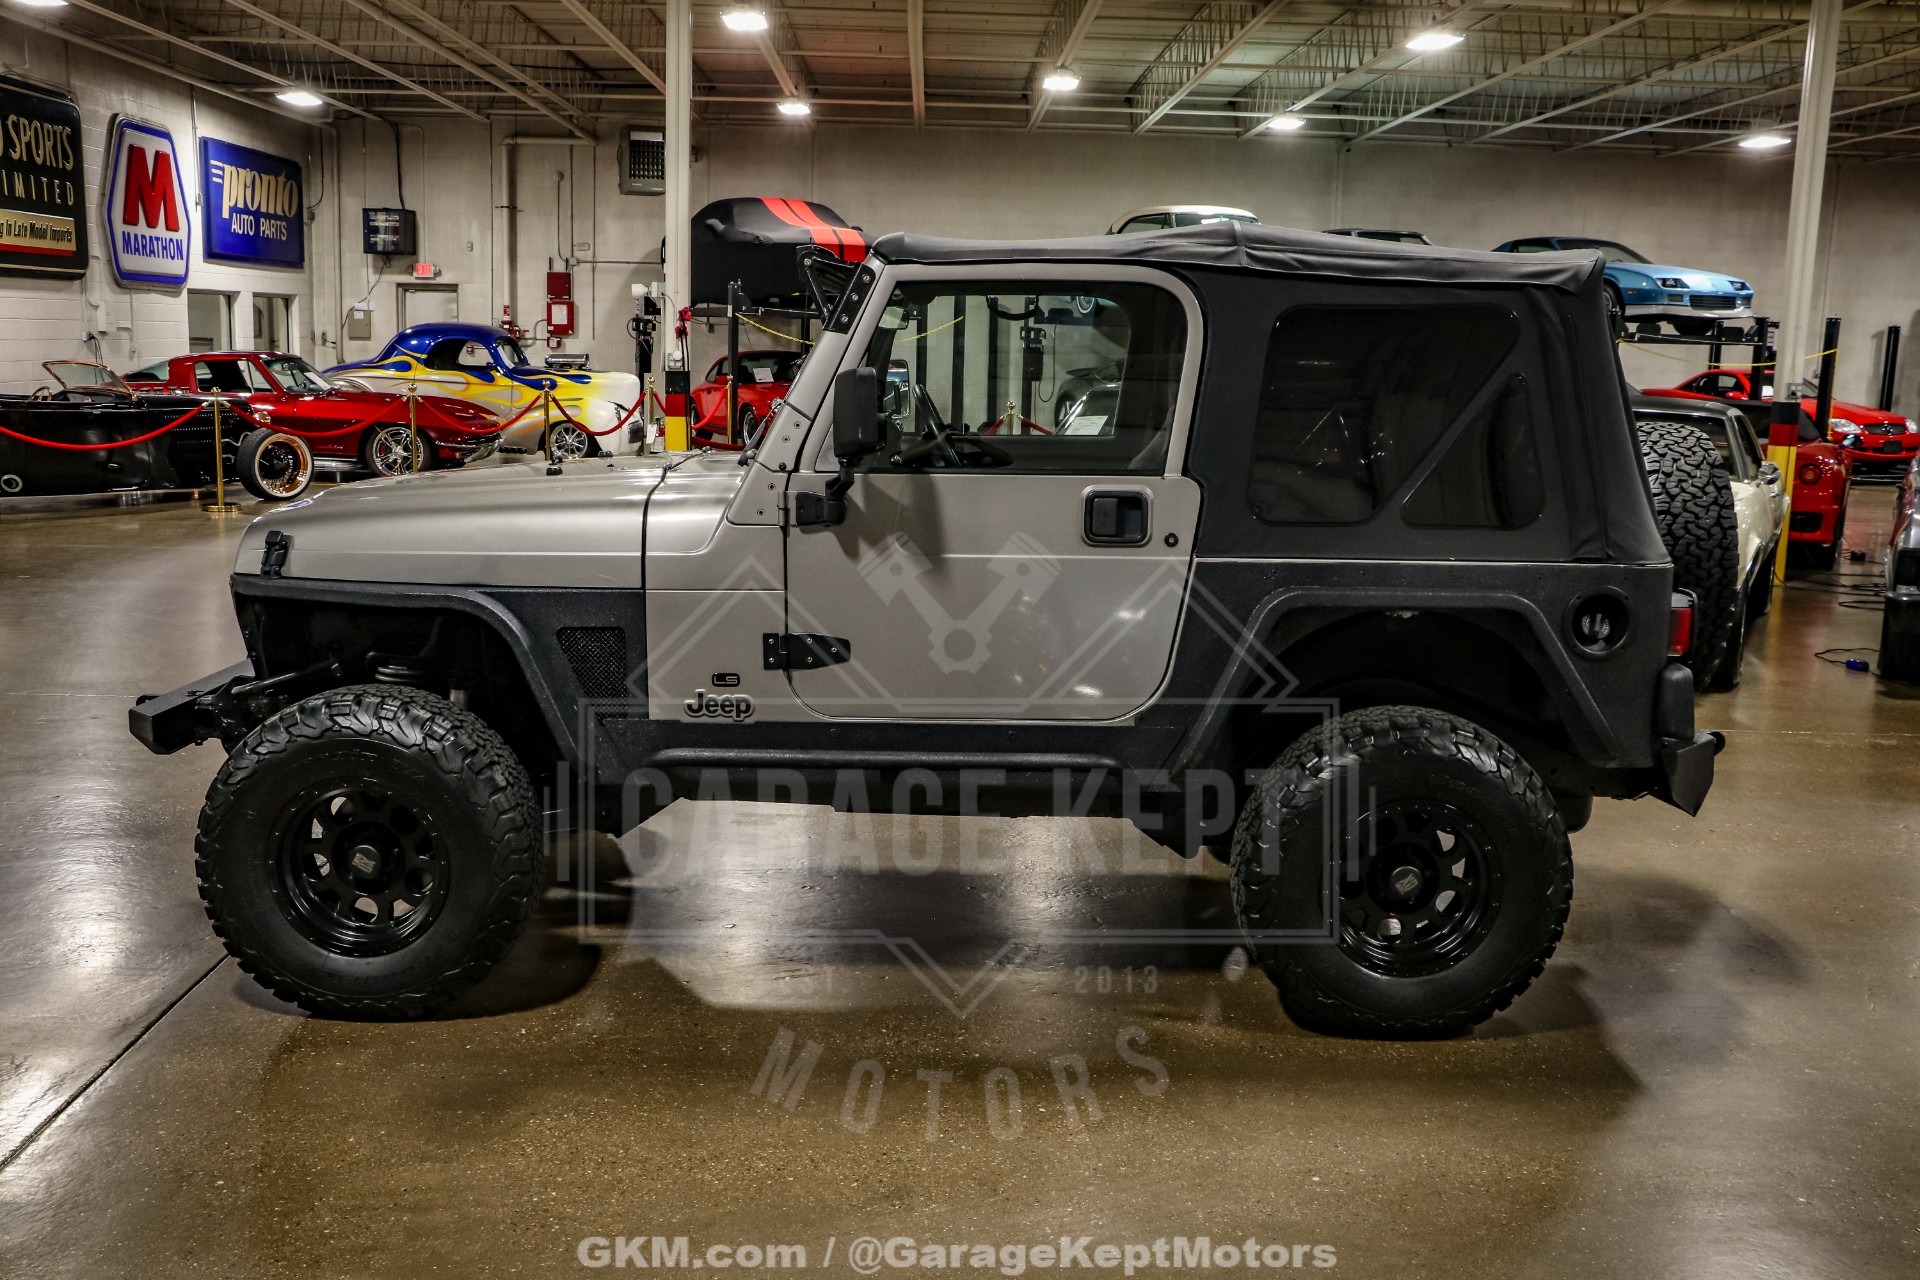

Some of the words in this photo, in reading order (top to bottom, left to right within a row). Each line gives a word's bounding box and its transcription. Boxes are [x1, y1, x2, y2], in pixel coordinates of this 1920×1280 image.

[7, 114, 74, 171] SPORTS
[122, 143, 180, 232] M
[222, 163, 299, 219] pronto
[29, 220, 49, 242] Model
[231, 212, 255, 236] AUTO
[260, 217, 287, 241] PARTS
[122, 230, 184, 261] MARATHON
[683, 688, 755, 722] Jeep
